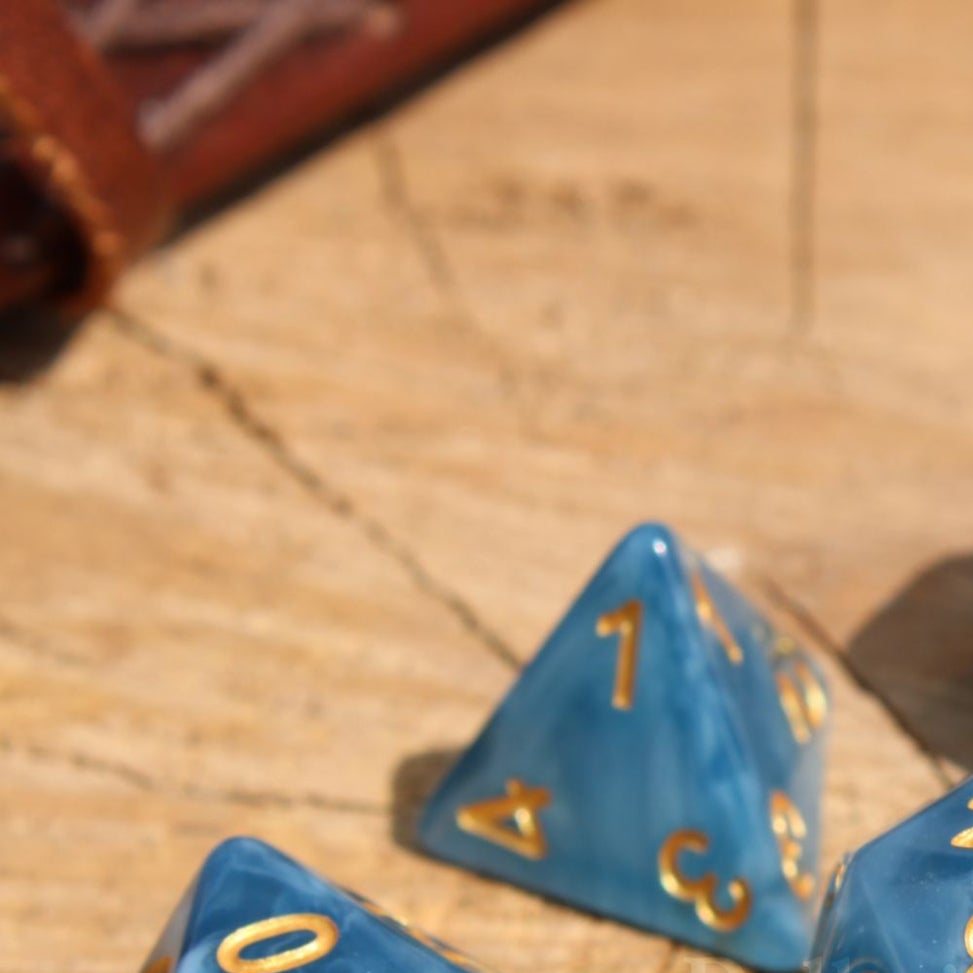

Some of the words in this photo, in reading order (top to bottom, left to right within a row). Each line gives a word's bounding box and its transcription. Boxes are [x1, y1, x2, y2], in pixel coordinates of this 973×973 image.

[595, 598, 644, 711] 1
[455, 778, 552, 861] 4
[657, 829, 753, 933] 3
